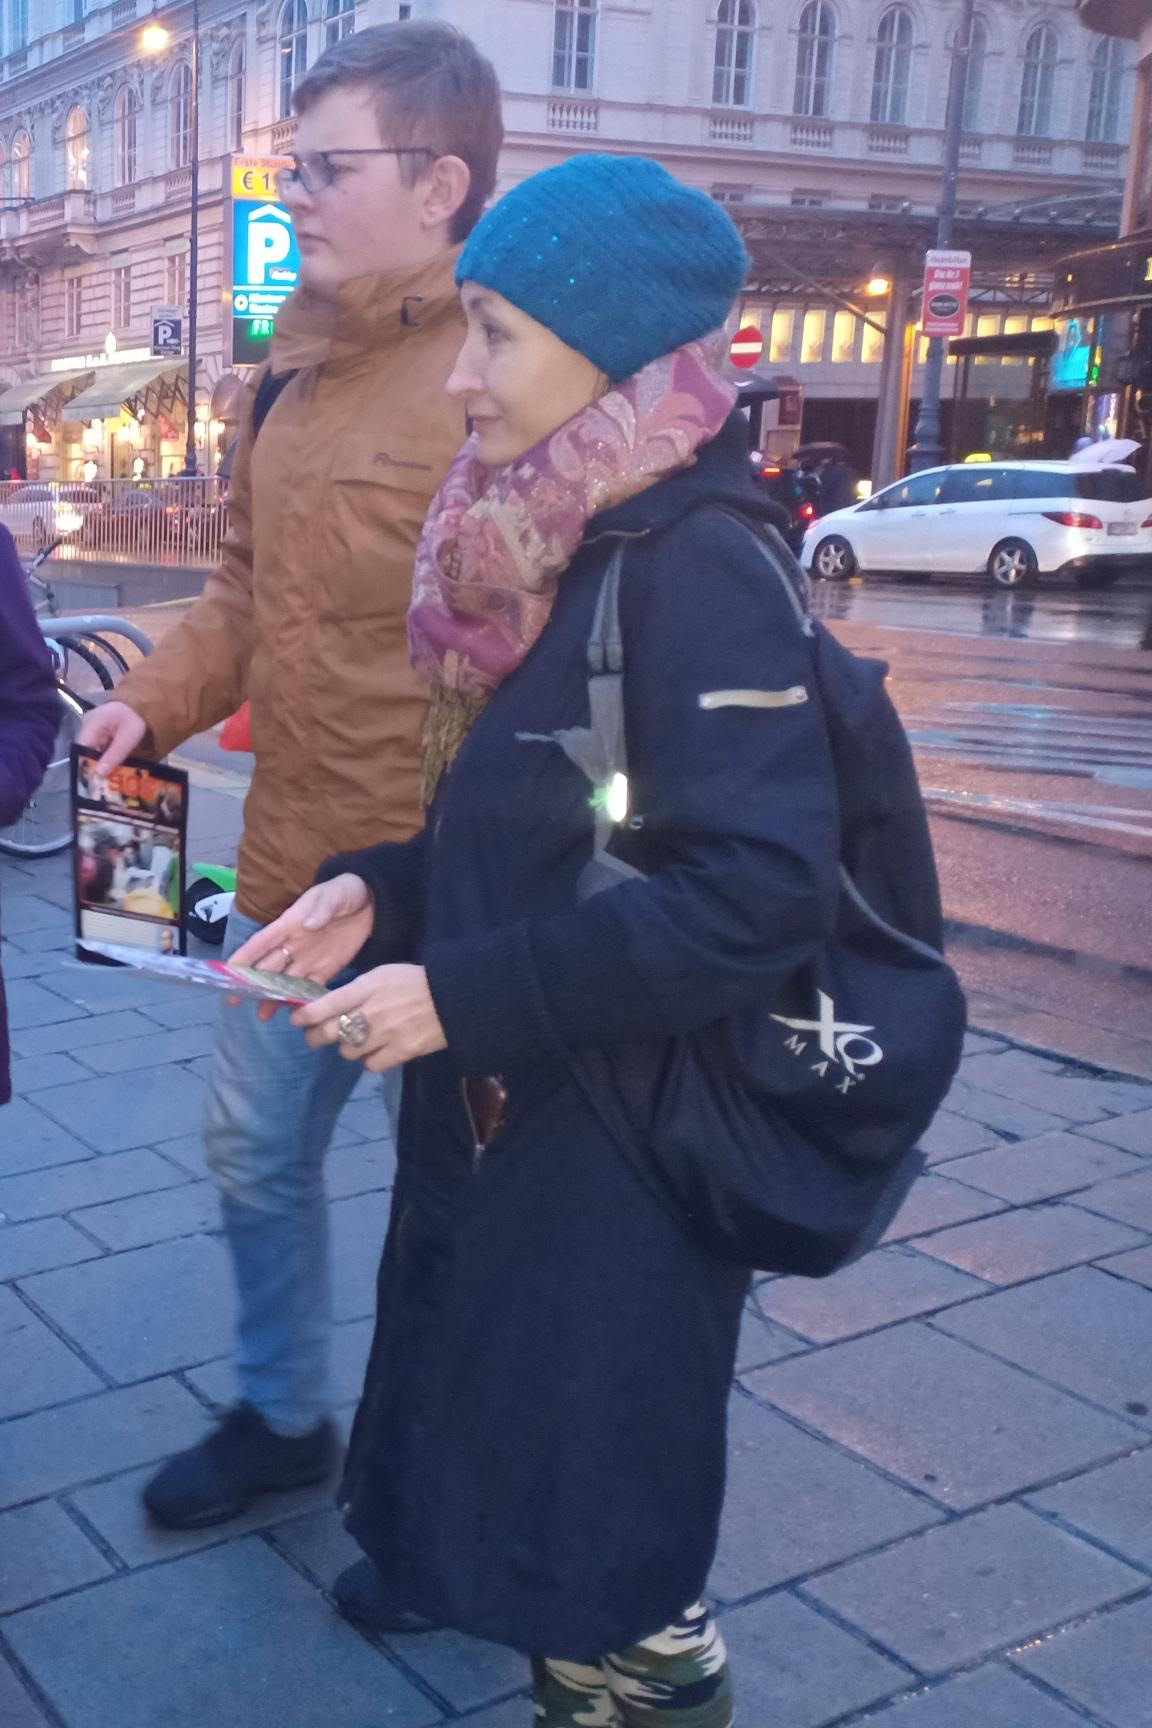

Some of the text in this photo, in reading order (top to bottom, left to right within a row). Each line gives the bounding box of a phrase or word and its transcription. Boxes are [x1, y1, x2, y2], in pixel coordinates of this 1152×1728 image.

[248, 222, 291, 284] P
[158, 325, 173, 345] P
[784, 1034, 857, 1095] MAX
